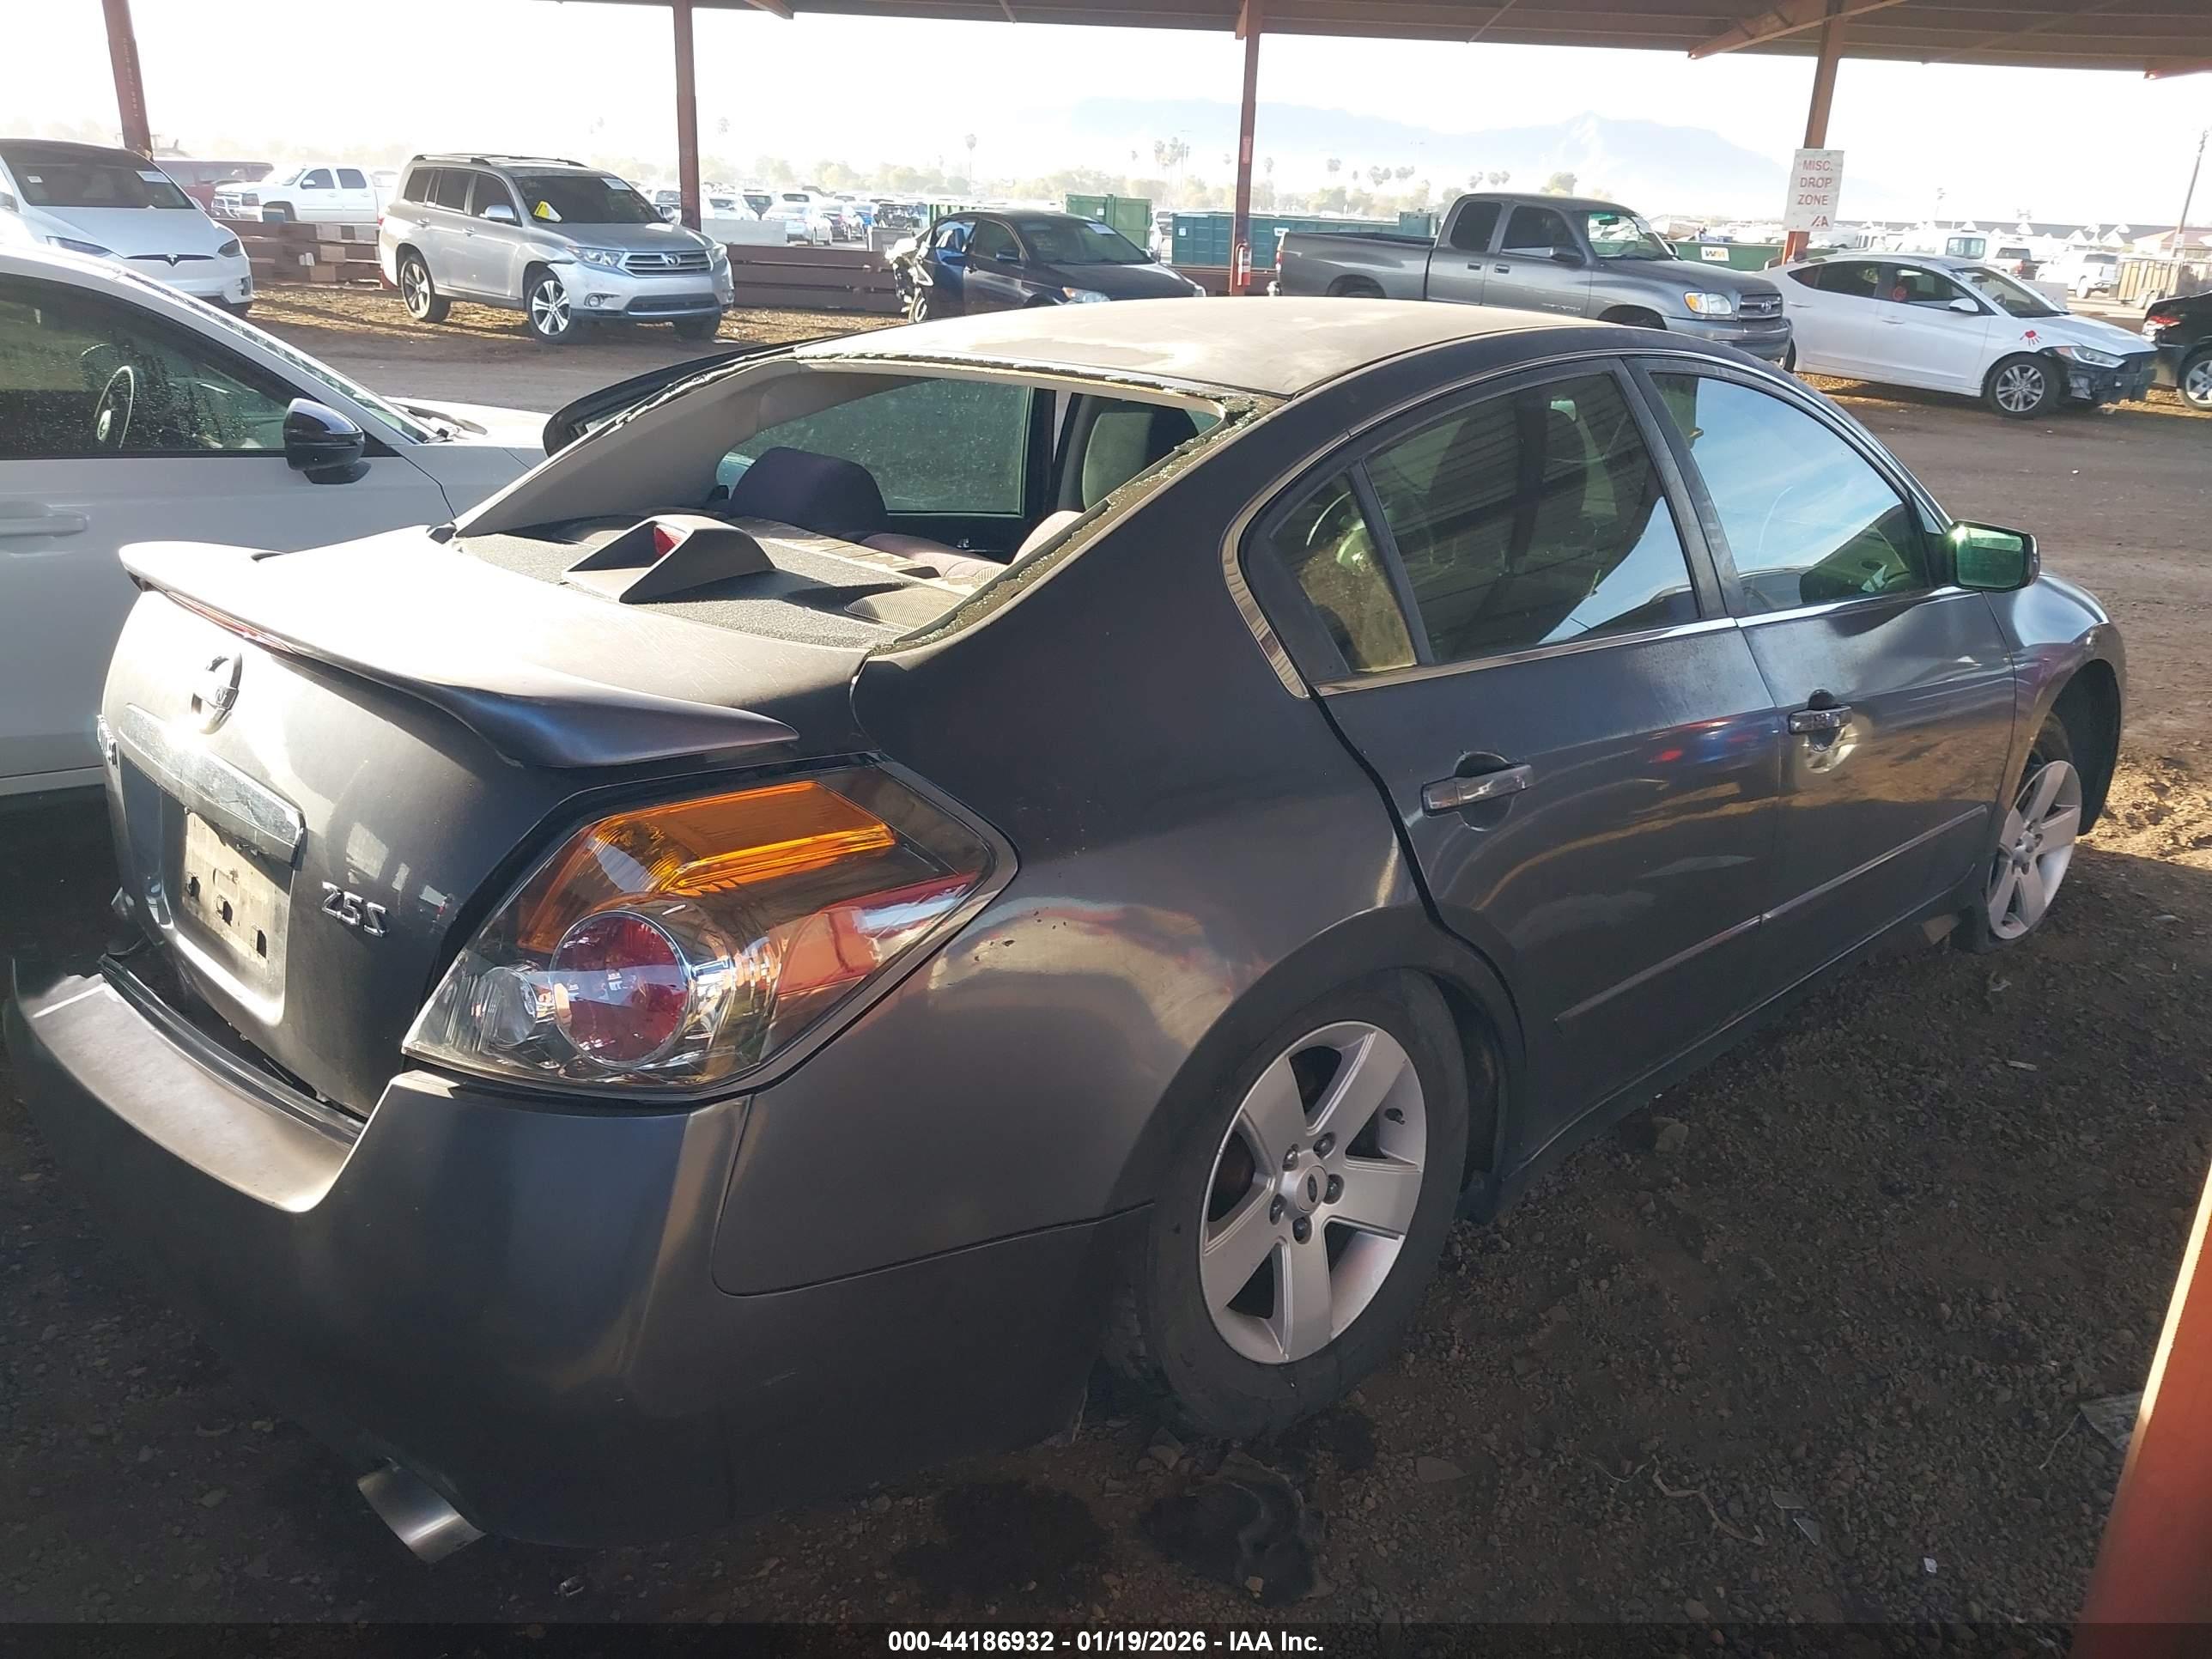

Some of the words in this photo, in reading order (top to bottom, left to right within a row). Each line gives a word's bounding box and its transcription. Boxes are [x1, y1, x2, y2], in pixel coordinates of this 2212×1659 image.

[1802, 160, 1833, 172] MISC.
[1800, 177, 1832, 188] DROP
[1797, 194, 1829, 206] ZONE
